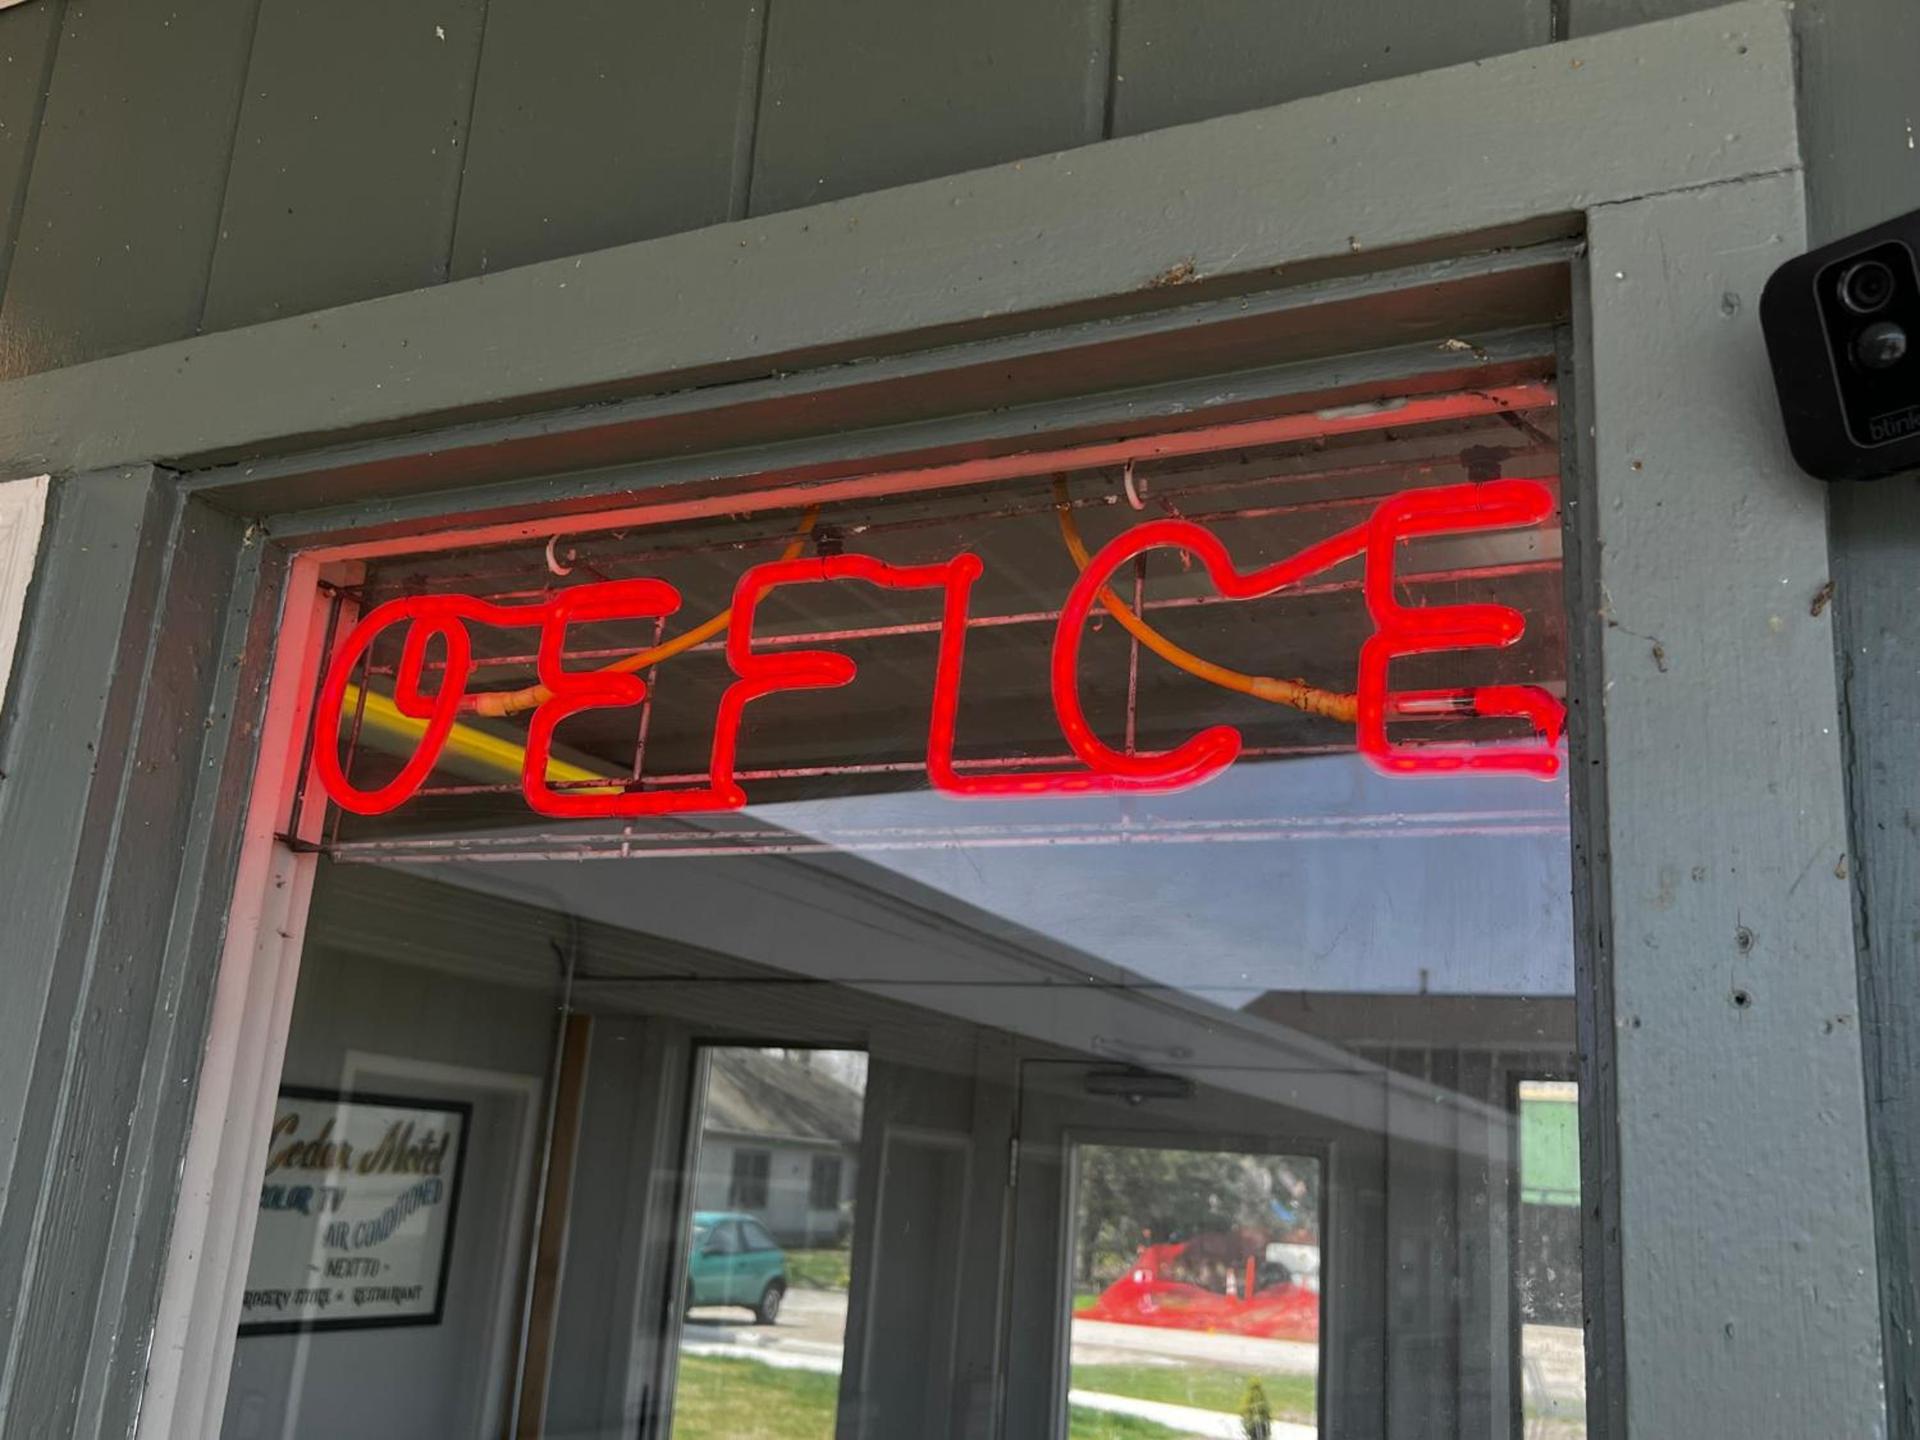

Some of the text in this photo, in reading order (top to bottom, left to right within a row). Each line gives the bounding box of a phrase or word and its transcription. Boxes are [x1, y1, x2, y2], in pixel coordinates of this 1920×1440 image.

[314, 478, 1558, 816] OFFICE
[357, 1118, 451, 1176] Motel
[323, 1177, 444, 1251] AIR CONDITIONED
[243, 1289, 291, 1311] ROCERY
[353, 1285, 424, 1306] RESTAURANT
